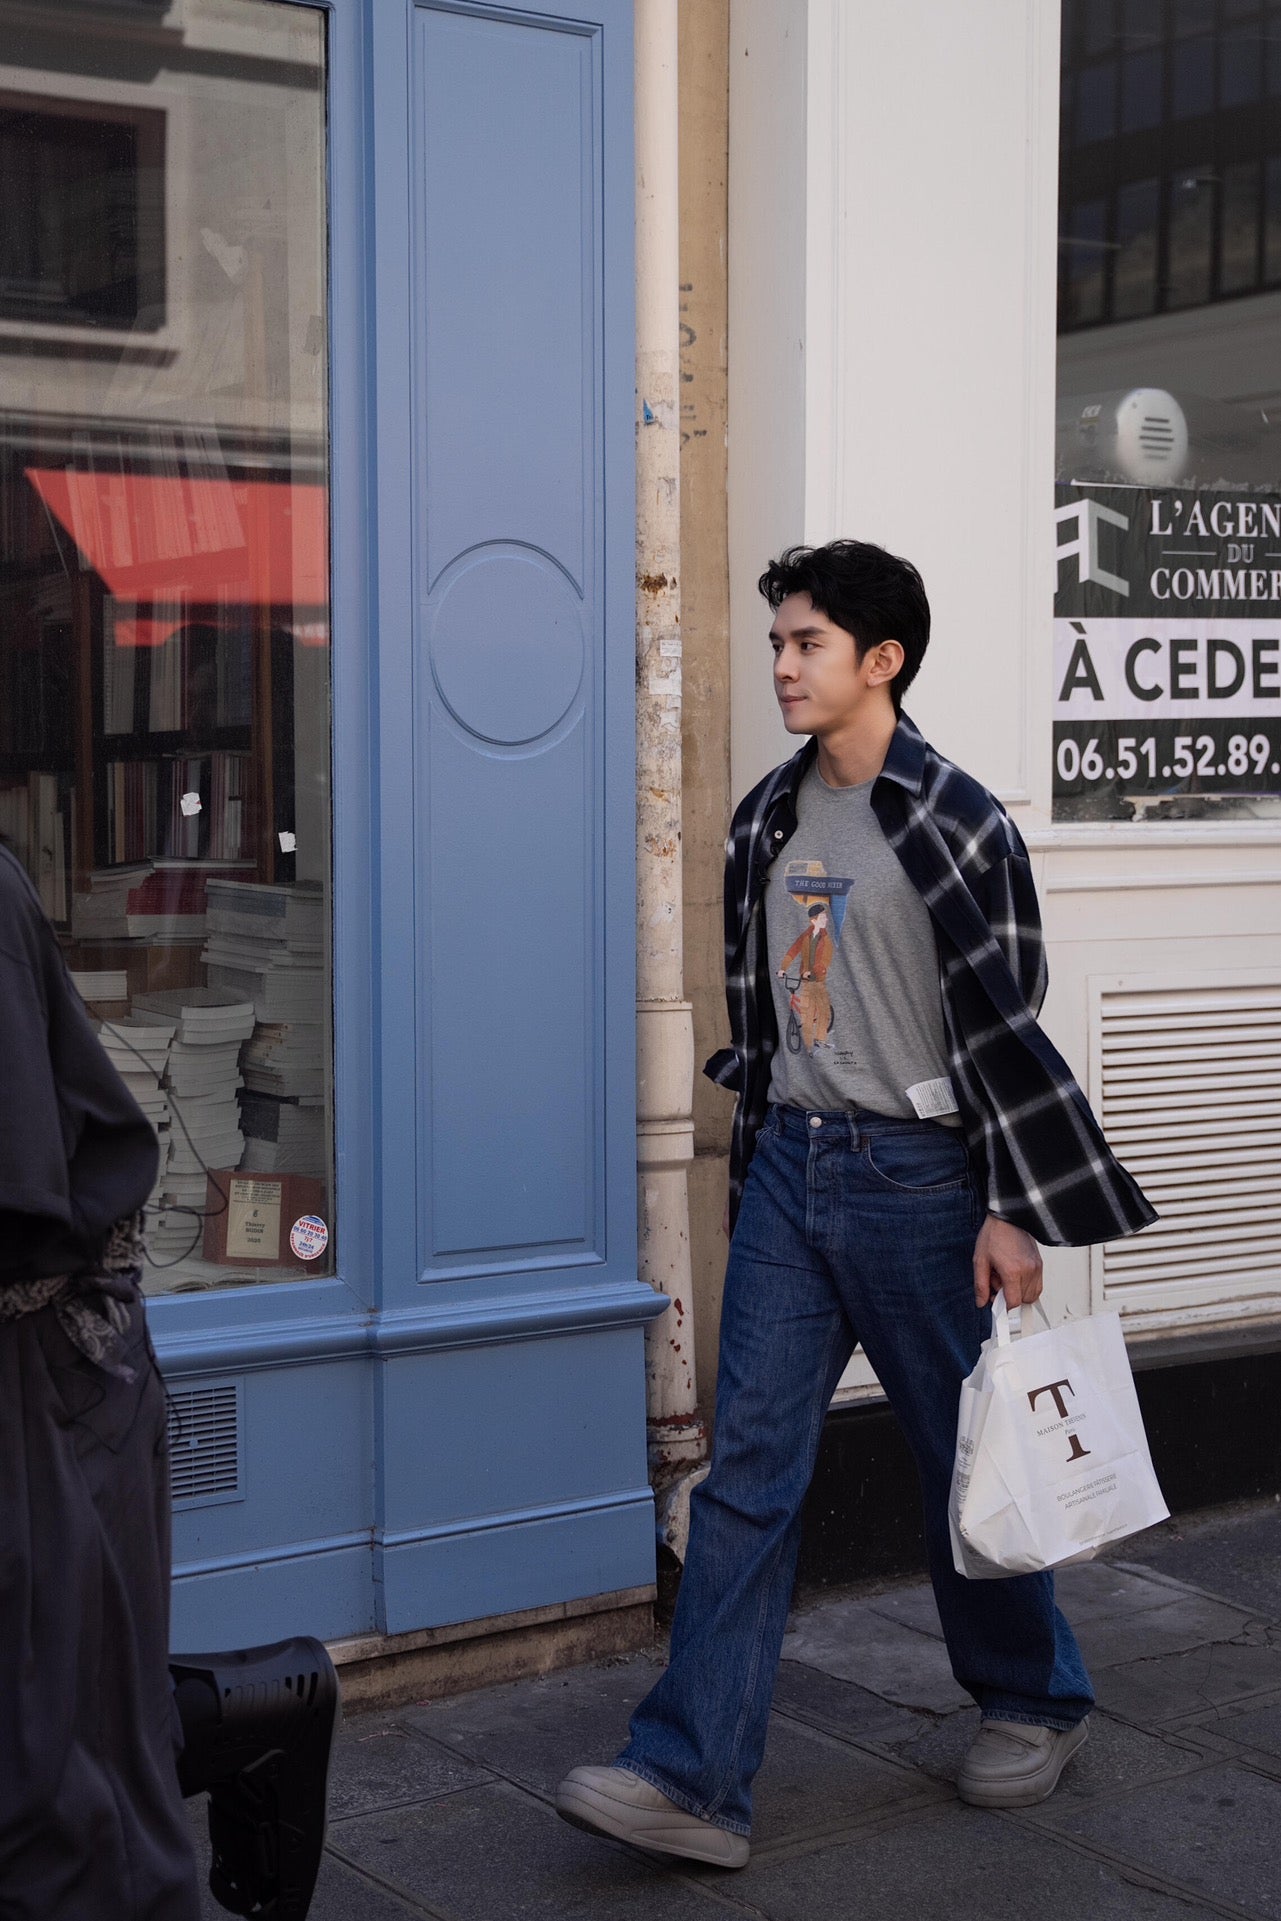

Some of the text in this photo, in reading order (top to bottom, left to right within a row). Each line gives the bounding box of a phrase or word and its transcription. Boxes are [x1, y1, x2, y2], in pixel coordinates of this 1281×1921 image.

[1227, 543, 1254, 563] DU
[1058, 622, 1280, 701] À CEDE
[1057, 734, 1280, 781] 06.51.52.89.
[299, 1220, 326, 1235] VITRIER
[1027, 1379, 1091, 1462] T
[1037, 1421, 1064, 1437] MAISON
